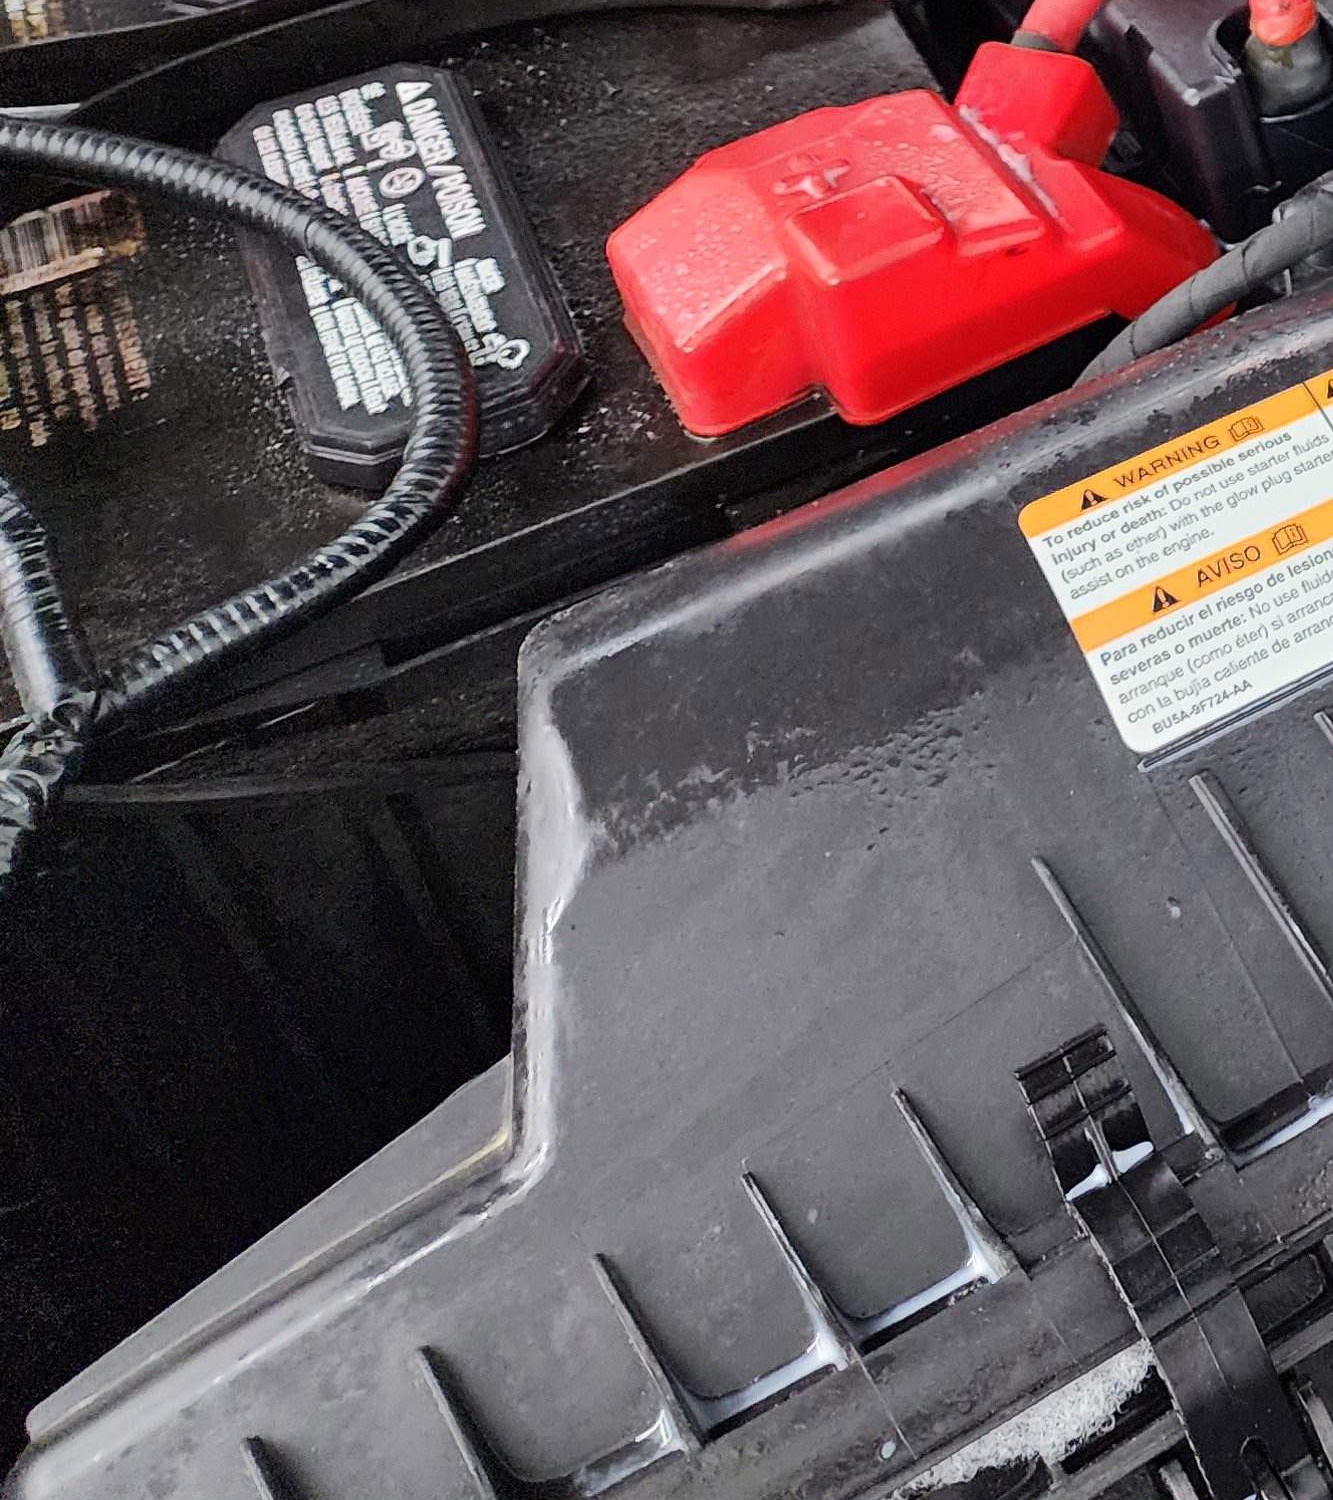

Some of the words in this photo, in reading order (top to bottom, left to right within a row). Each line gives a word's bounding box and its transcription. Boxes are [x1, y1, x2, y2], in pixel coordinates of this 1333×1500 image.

[1040, 533, 1064, 549] To
[1065, 508, 1120, 539] reduce
[1121, 494, 1152, 514] risk
[1152, 483, 1170, 499] of
[1171, 456, 1236, 494] possible
[1236, 431, 1292, 462] serious
[1050, 537, 1096, 566] injury
[1099, 528, 1116, 543] or
[1119, 506, 1168, 534] death:
[1167, 496, 1192, 512] Do
[1192, 482, 1218, 501] not
[1217, 471, 1245, 489] use
[1246, 450, 1290, 477] starter
[1291, 433, 1330, 456] fluids
[1111, 434, 1221, 488] WARNING
[1060, 556, 1103, 584] (such
[1103, 547, 1124, 562] as
[1124, 524, 1168, 552] ether)
[1167, 512, 1199, 532] with
[1198, 500, 1224, 518] the
[1225, 484, 1259, 509] glow
[1260, 470, 1293, 494] plug
[1069, 571, 1114, 600] assist
[1113, 562, 1135, 579] on
[1134, 551, 1160, 569] the
[1161, 527, 1215, 557] engine.
[1196, 544, 1261, 588] AVISO
[1098, 641, 1138, 667] Para
[1139, 613, 1194, 649] reducir
[1197, 602, 1214, 620] el
[1214, 582, 1264, 613] riesgo
[1265, 571, 1286, 588] de
[1108, 649, 1172, 686] severas
[1173, 642, 1186, 655] o
[1186, 612, 1247, 649] muerte:
[1247, 601, 1271, 619] No
[1271, 587, 1300, 607] use
[1117, 665, 1185, 705] arranque
[1186, 642, 1233, 674] (como
[1234, 622, 1269, 649] éter)
[1126, 702, 1156, 724] con
[1155, 695, 1173, 709] la
[1213, 647, 1270, 682] caliente
[1270, 637, 1291, 654] de
